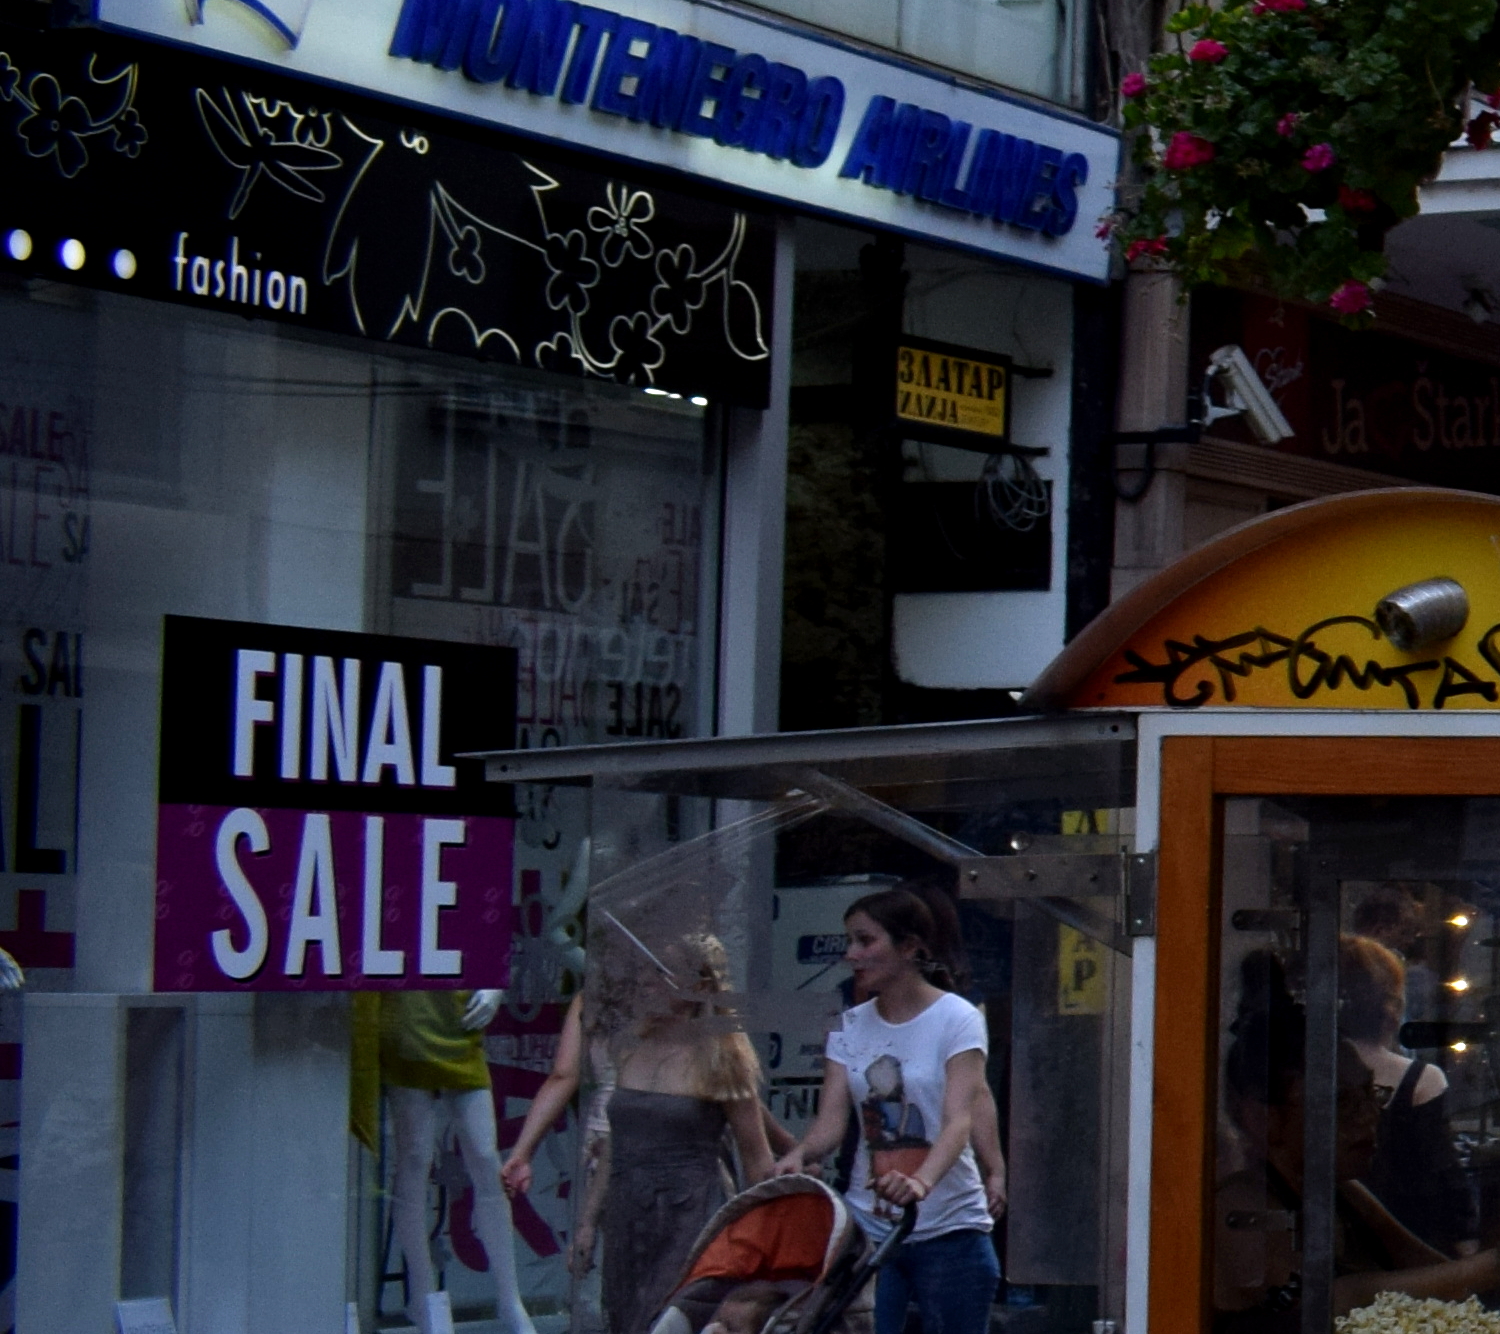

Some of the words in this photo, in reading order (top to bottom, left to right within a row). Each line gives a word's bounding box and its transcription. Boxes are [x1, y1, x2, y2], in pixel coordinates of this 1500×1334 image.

[840, 95, 1087, 238] AIRLINES
[173, 231, 309, 316] fashion
[900, 350, 1002, 400] ЗЛАТАР
[1322, 378, 1369, 444] Ja
[231, 648, 457, 789] FINAL
[210, 808, 467, 981] SALE
